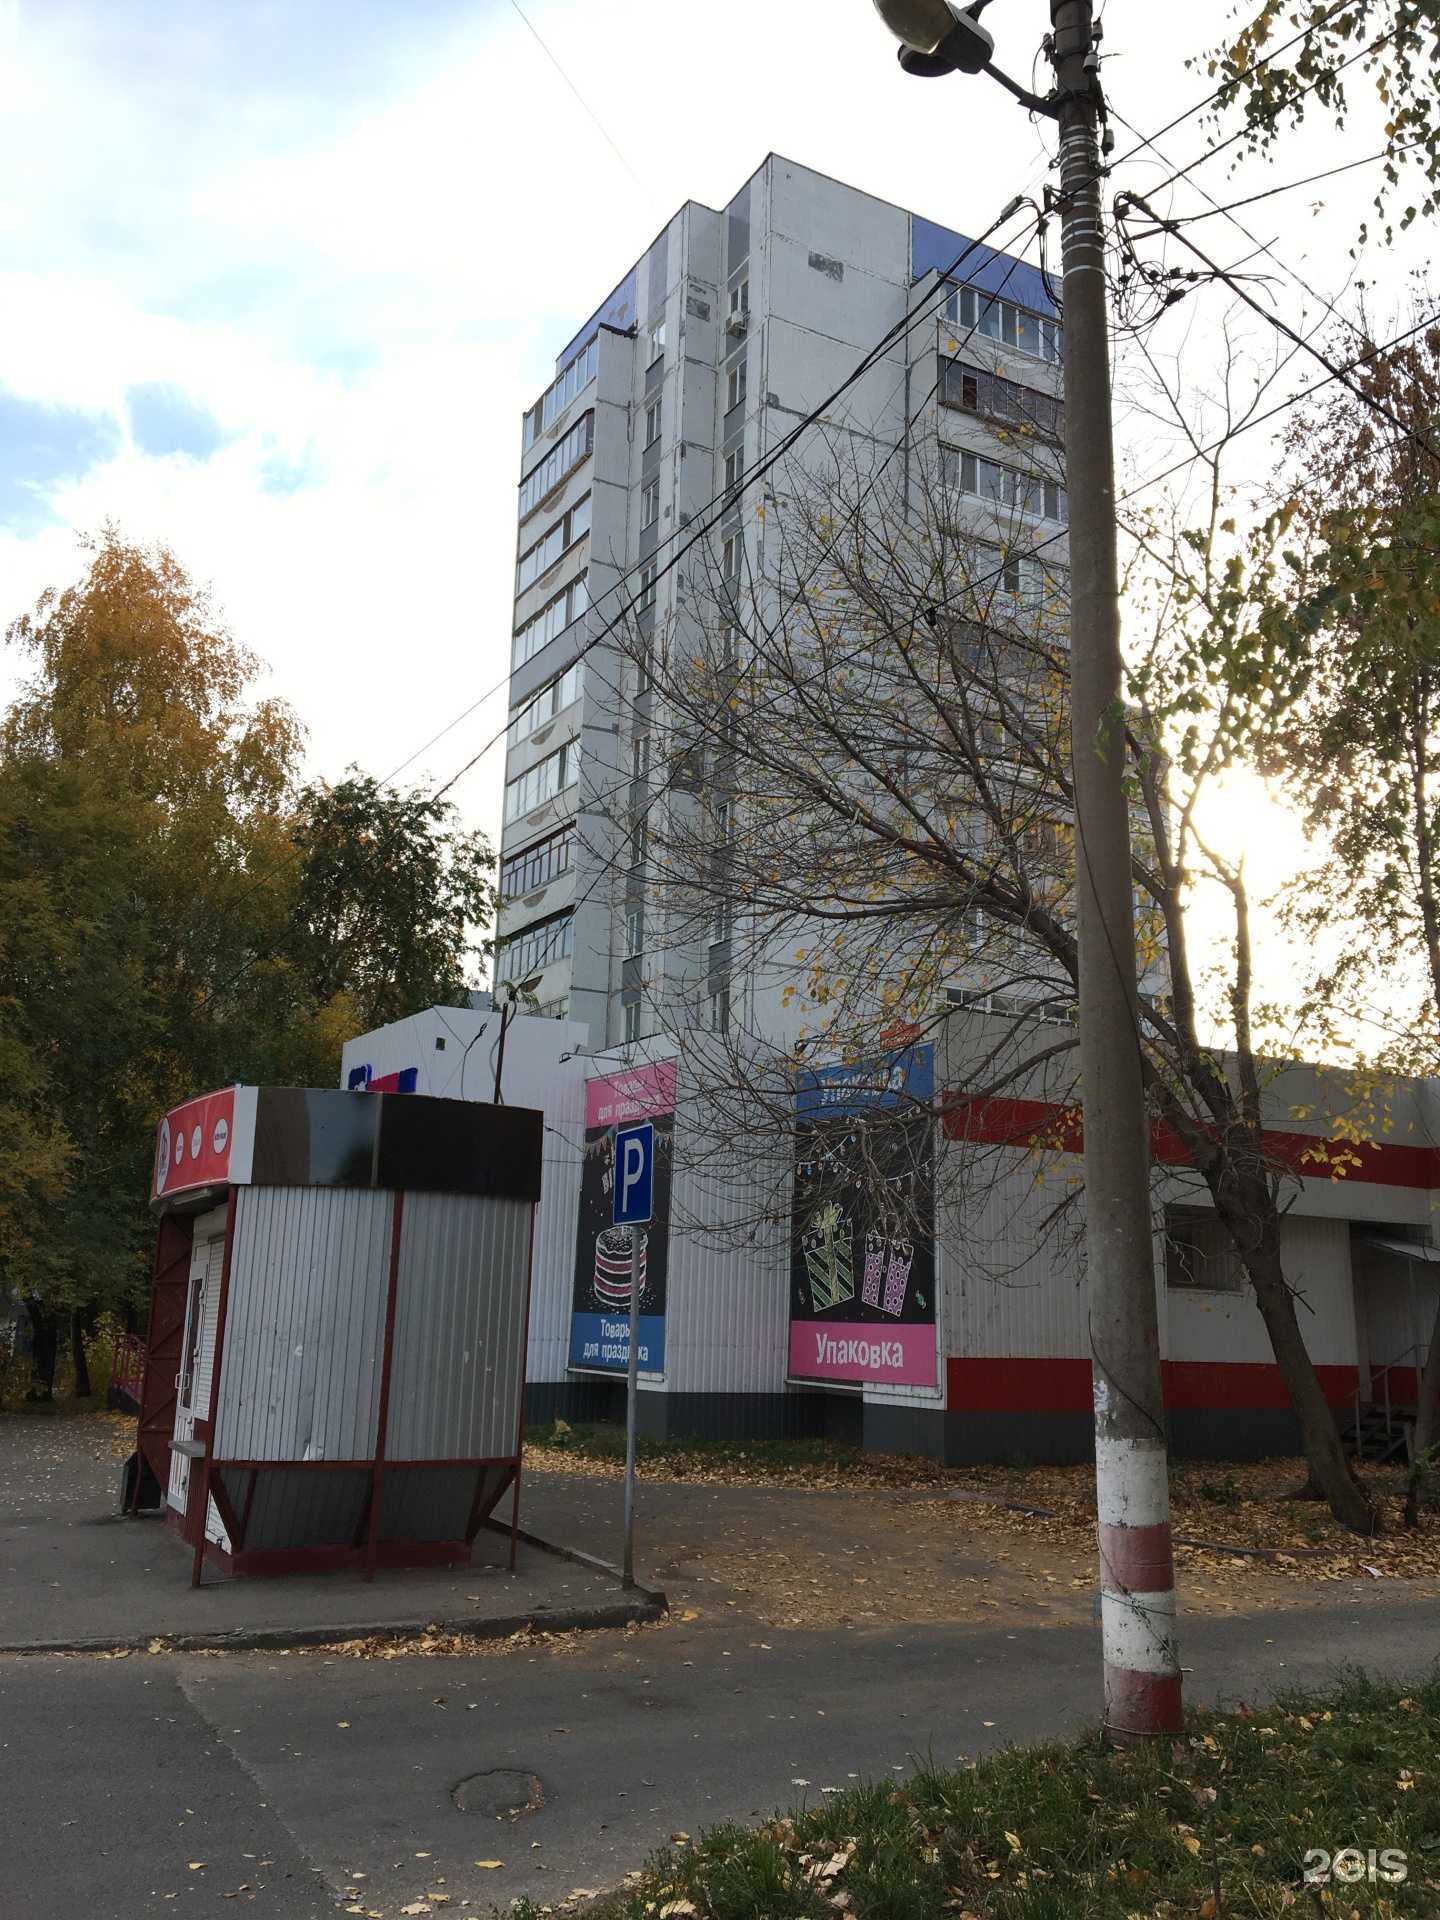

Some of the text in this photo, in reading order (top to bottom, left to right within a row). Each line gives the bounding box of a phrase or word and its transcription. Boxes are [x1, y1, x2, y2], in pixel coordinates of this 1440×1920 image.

[583, 1342, 649, 1363] для праздка
[816, 1333, 904, 1368] Упаковка
